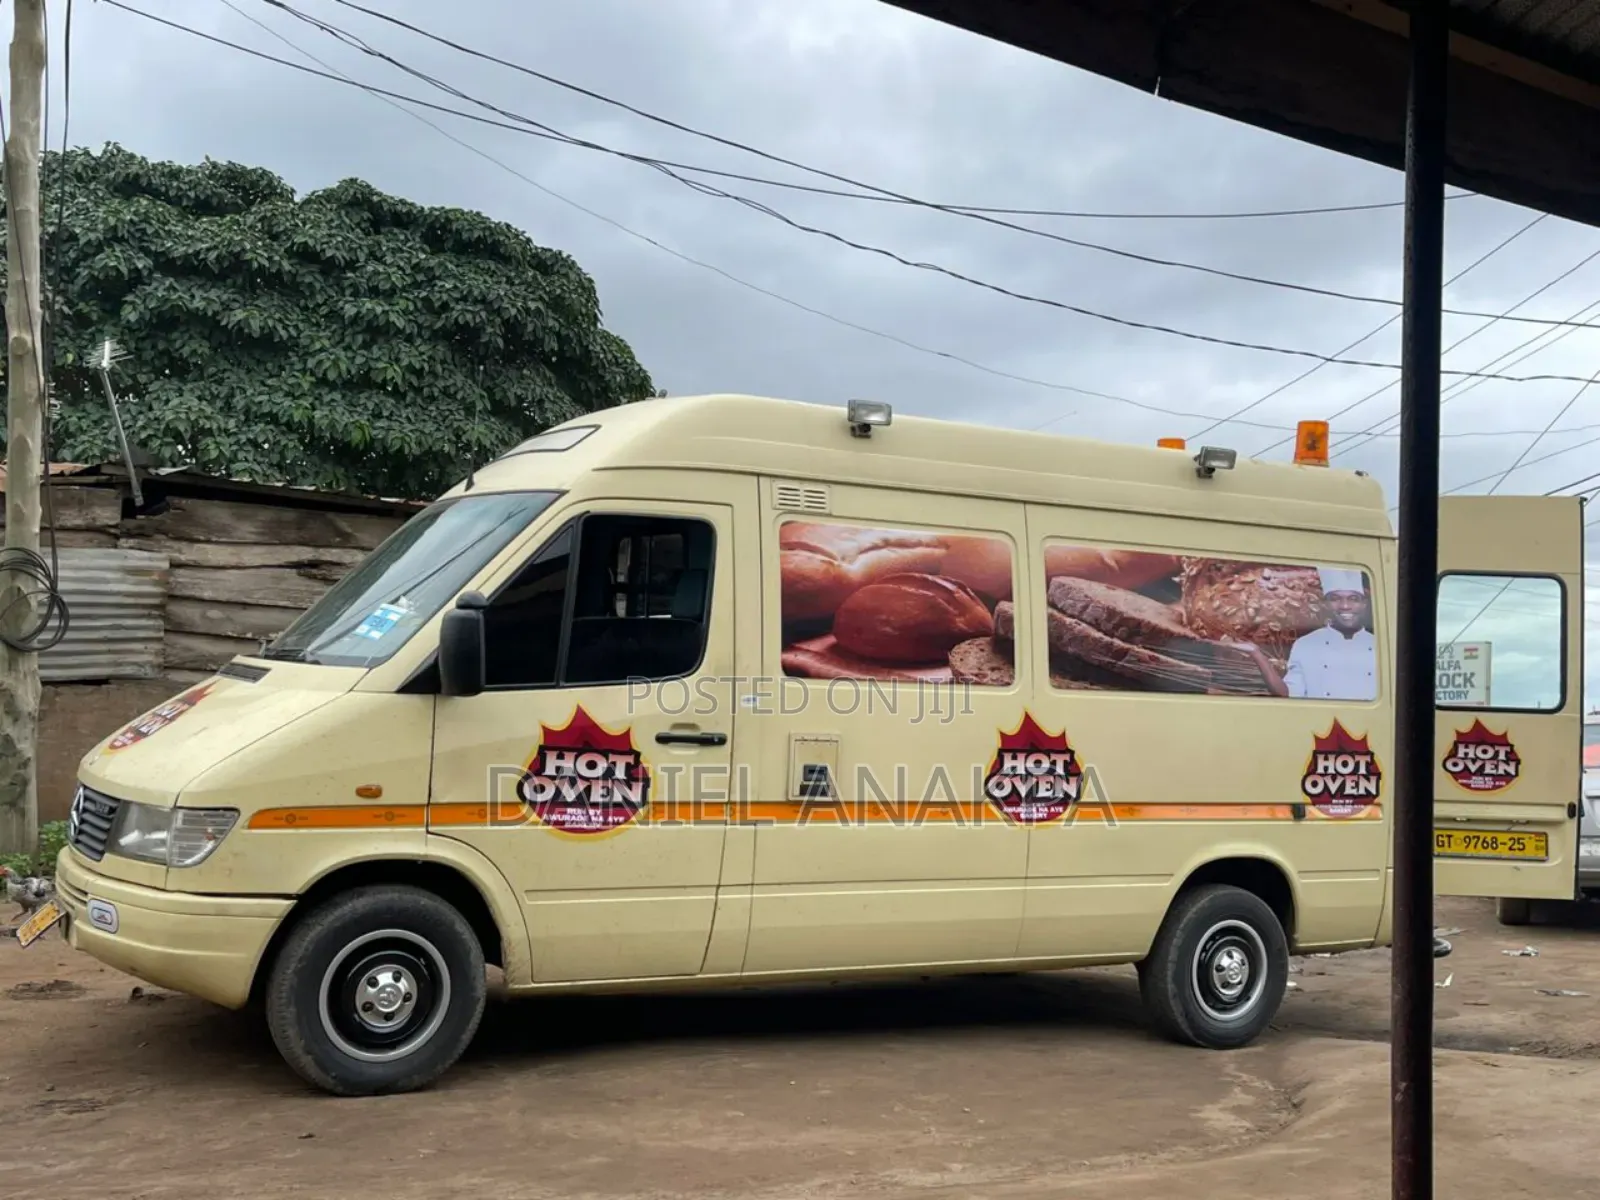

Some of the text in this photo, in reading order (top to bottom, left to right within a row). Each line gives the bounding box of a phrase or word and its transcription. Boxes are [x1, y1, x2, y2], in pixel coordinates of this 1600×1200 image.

[1457, 743, 1511, 760] HOT
[542, 750, 635, 780] HOT
[1000, 752, 1071, 776] HOT
[1316, 753, 1371, 775] HOT
[1445, 757, 1517, 776] OVEN
[522, 776, 645, 803] OVEN
[987, 774, 1080, 799] OVEN
[1304, 774, 1378, 796] OVEN
[1435, 833, 1454, 849] GT
[1463, 835, 1526, 852] 9768-25
